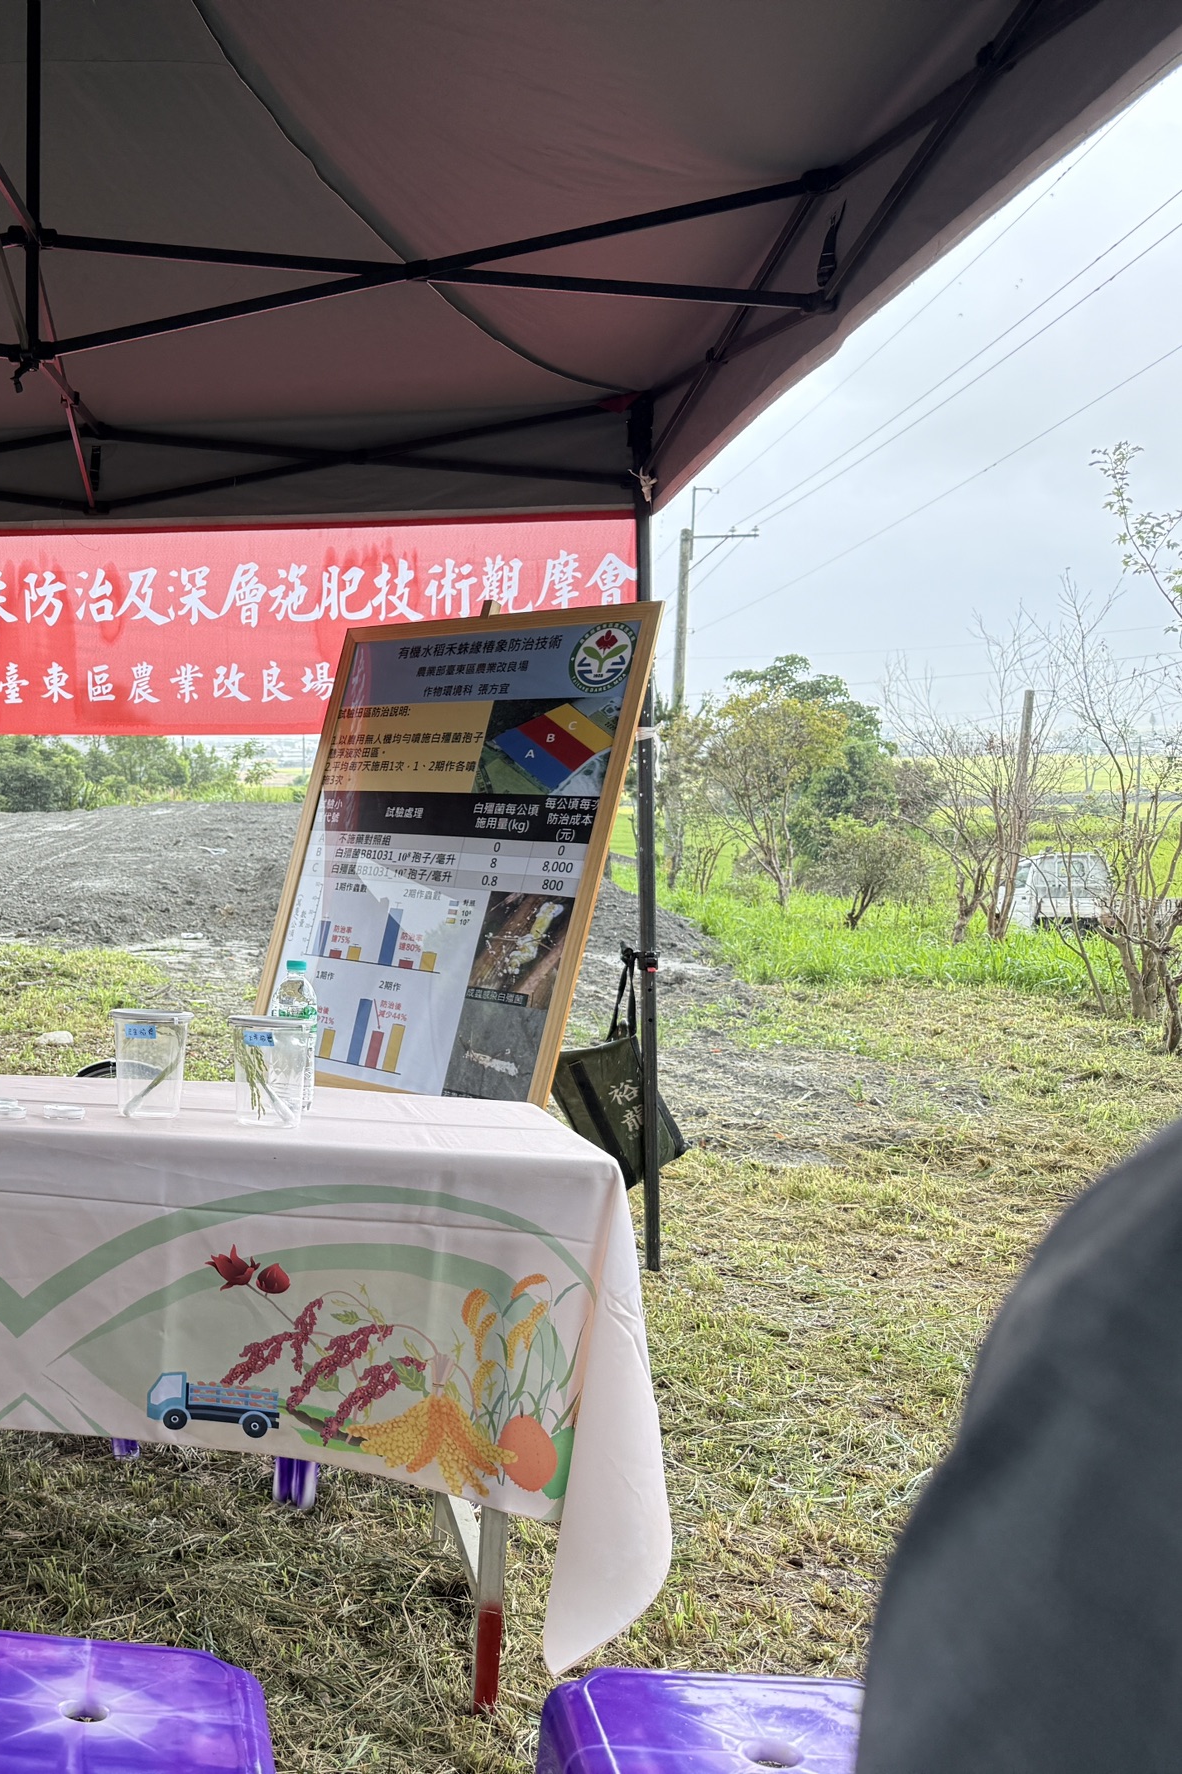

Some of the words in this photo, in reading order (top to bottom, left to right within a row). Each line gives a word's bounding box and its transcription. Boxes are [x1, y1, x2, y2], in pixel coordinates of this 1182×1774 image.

[398, 634, 563, 660] 有機水稻禾蛛緣椿象防治技術
[416, 661, 529, 677] 農業部臺東區農業改良場
[423, 685, 473, 698] 作物環境科
[477, 682, 510, 695] 張方宜
[338, 705, 411, 719] 試驗田區防治說明:
[568, 721, 578, 731] C
[546, 733, 556, 743] B
[524, 749, 535, 759] A
[385, 806, 424, 819] 試驗處理
[472, 802, 540, 816] 白殭菌每公頃
[474, 817, 530, 833] 施用量(kg)
[547, 812, 593, 826] 防治成本
[338, 833, 392, 846] 不施藥對照組
[555, 828, 576, 842] (元)
[315, 847, 322, 857] B
[493, 842, 501, 852] 0
[557, 845, 565, 856] 0
[312, 863, 319, 873] C
[490, 858, 497, 868] 8
[542, 861, 574, 873] 8,000
[481, 875, 498, 886] 0.8
[541, 879, 563, 891] 800
[378, 980, 402, 992] 2期作
[380, 1000, 402, 1011] 防治後
